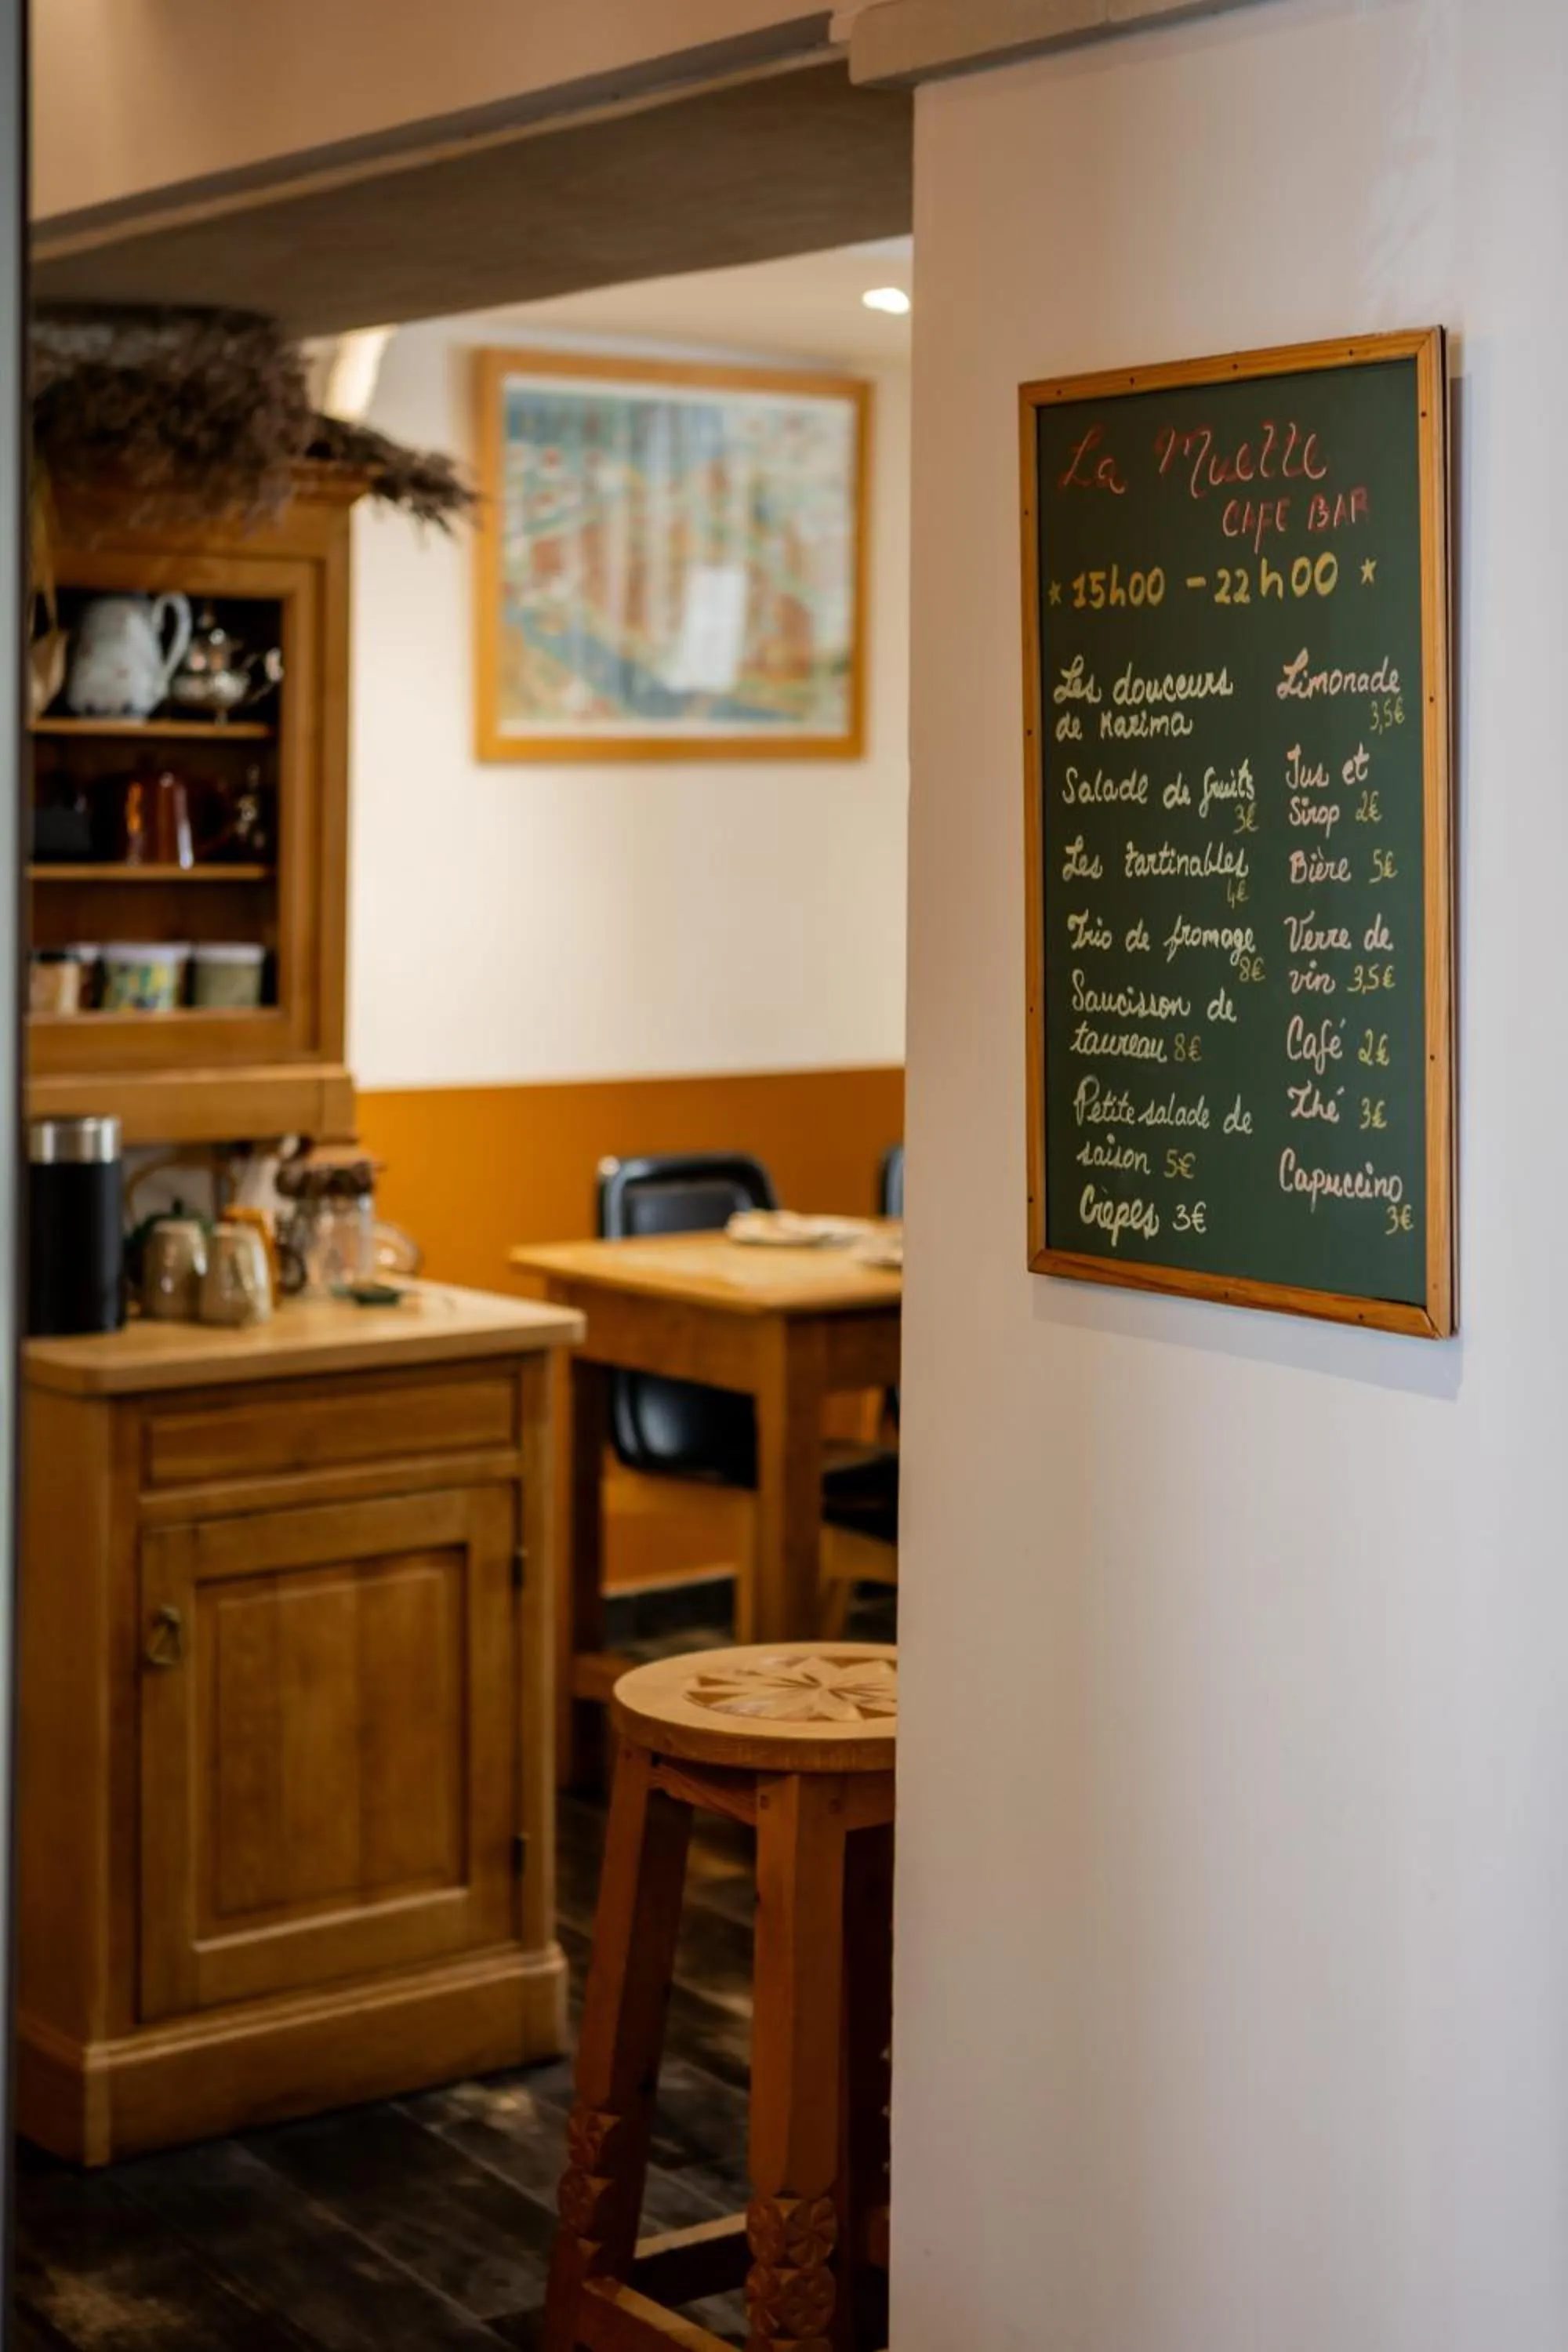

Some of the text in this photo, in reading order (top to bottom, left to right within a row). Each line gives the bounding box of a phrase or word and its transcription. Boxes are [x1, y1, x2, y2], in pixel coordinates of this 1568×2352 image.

[1057, 419, 1127, 495] La
[1307, 485, 1370, 532] BAR
[1073, 564, 1166, 609] 15h00
[1053, 655, 1233, 705] Les douceurs
[1276, 647, 1400, 699] Limonade
[1056, 712, 1083, 742] de
[1062, 758, 1254, 818] Salade de fruits
[1286, 742, 1370, 789] Jus et
[1289, 790, 1383, 840] Sirop 2€
[1062, 835, 1102, 881] Les
[1289, 846, 1399, 884] Bière 5€
[1067, 909, 1256, 966] Trio de fromage
[1283, 909, 1394, 953] Verre de
[1239, 957, 1265, 981] 8€
[1289, 960, 1336, 995] vin
[1072, 968, 1237, 1022] Saucisson de
[1069, 1020, 1202, 1063] taureau 8€
[1287, 1014, 1390, 1075] Café 2€
[1073, 1074, 1253, 1134] Petite salade de
[1287, 1079, 1388, 1129] Thé 3€
[1076, 1134, 1196, 1179] saison 5€
[1279, 1148, 1403, 1214] Capuccino
[1173, 1201, 1207, 1234] 3€
[1385, 1204, 1414, 1235] 3€
